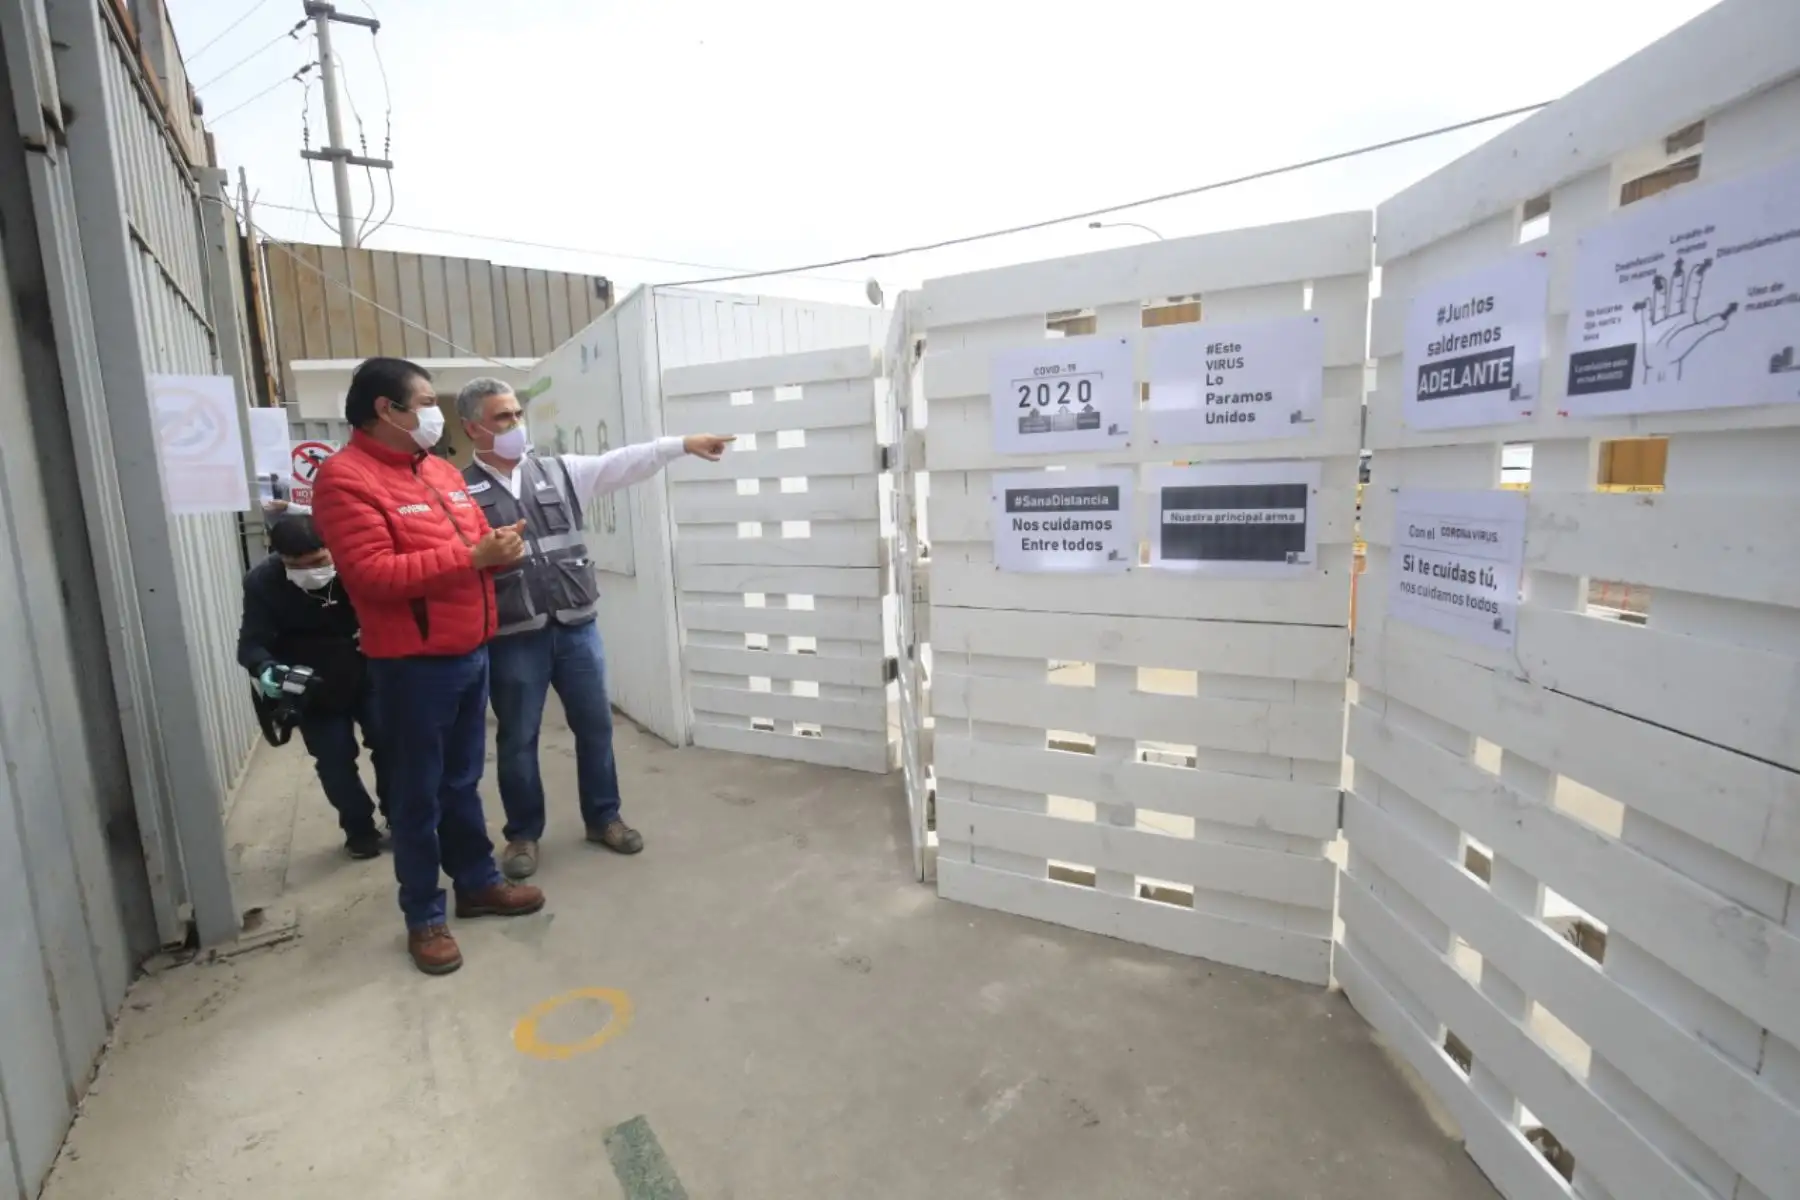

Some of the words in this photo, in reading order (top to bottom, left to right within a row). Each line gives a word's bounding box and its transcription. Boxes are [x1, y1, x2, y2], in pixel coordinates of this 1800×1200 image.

[1437, 296, 1494, 326] #Juntos
[1206, 342, 1242, 355] #Este
[1428, 326, 1502, 357] saldremos
[1205, 357, 1245, 371] VIRUS
[1206, 373, 1224, 386] Lo
[1418, 356, 1512, 395] ADELANTE
[1018, 379, 1092, 408] 2020
[1206, 391, 1273, 405] Paramos
[1206, 410, 1257, 424] Unidos
[1014, 494, 1109, 507] #SanaDistancia
[1012, 518, 1040, 531] Nos
[1042, 517, 1113, 531] cuidamos
[1170, 511, 1213, 522] Nuestra
[1214, 511, 1262, 525] principal
[1264, 512, 1296, 522] arma
[1427, 527, 1436, 541] el
[1021, 537, 1060, 551] Entre
[1062, 537, 1104, 551] todos
[1402, 554, 1415, 573] Si
[1418, 557, 1431, 576] te
[1400, 581, 1417, 595] nos
[1417, 584, 1465, 607] cuidamos
